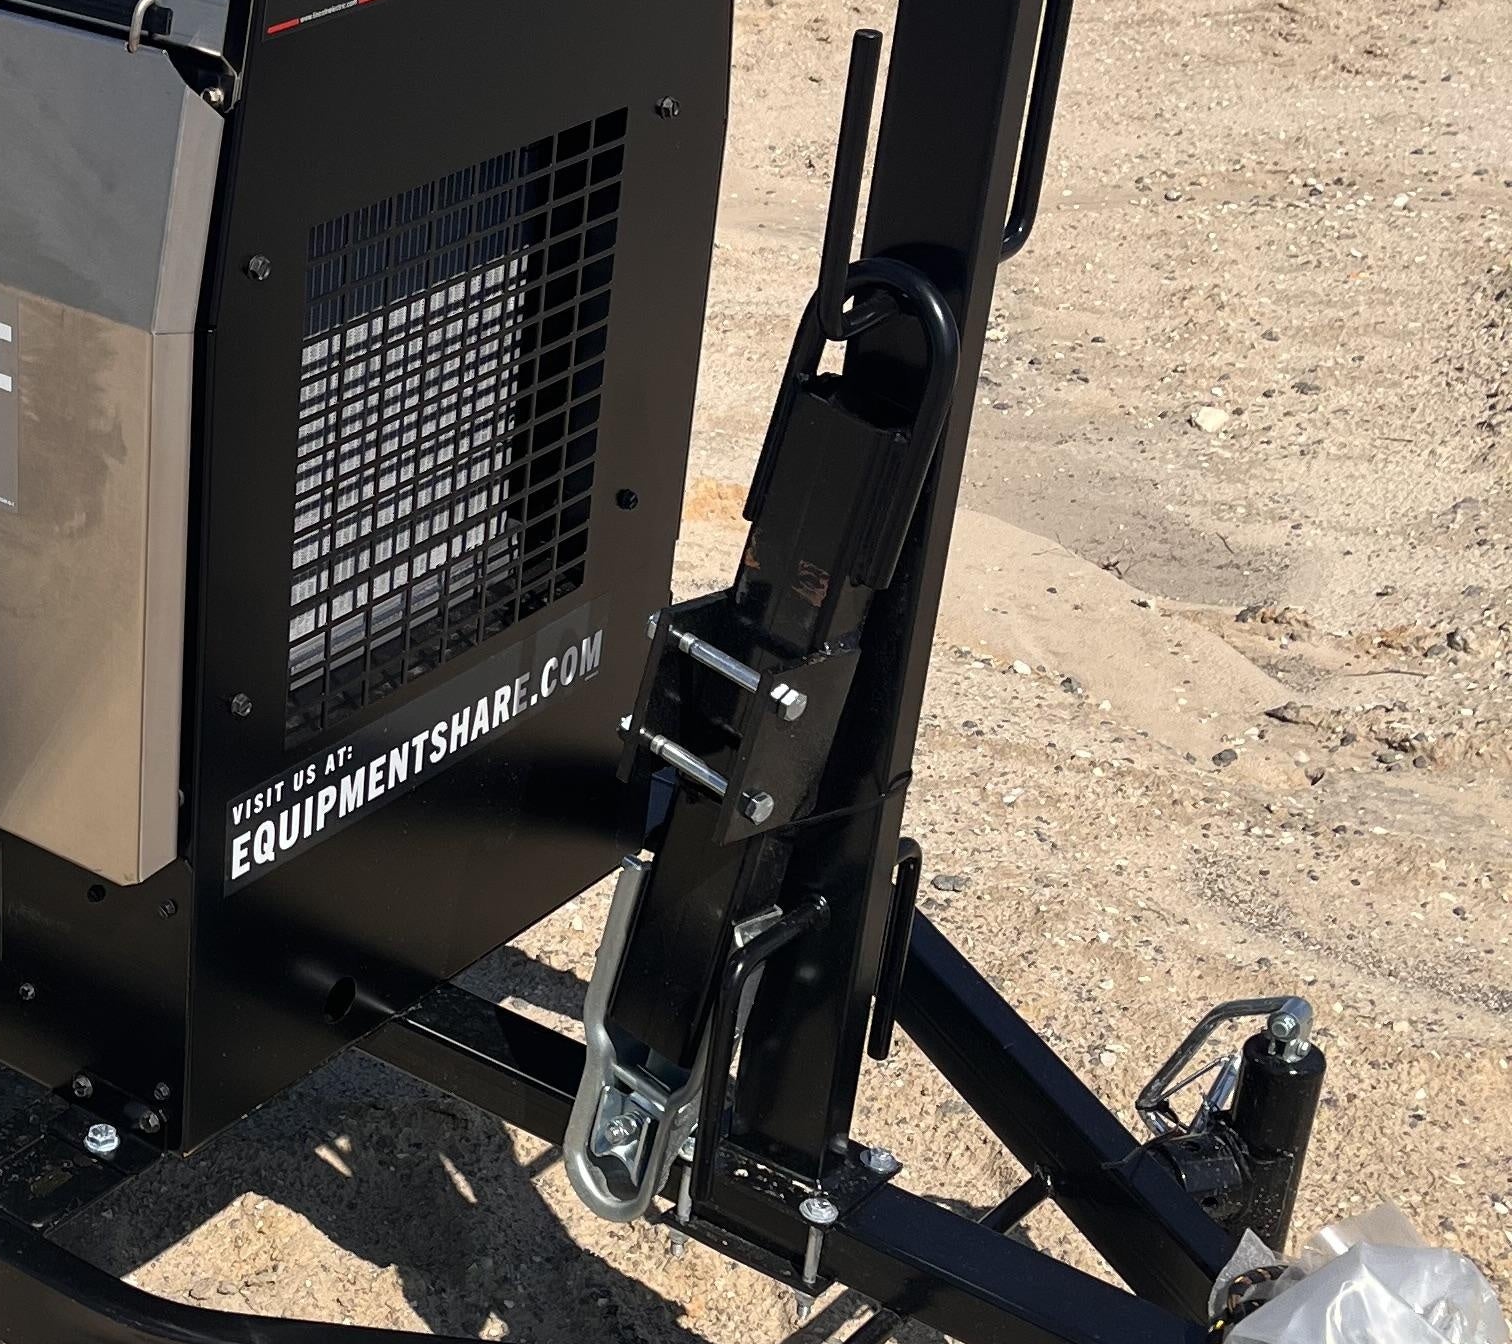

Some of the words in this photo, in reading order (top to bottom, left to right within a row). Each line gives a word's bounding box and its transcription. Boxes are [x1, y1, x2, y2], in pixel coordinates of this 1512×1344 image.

[231, 629, 604, 880] EQUIPMENTSHARE.COM
[232, 780, 285, 826] VISIT
[293, 763, 316, 792] US
[325, 744, 353, 775] AT:
